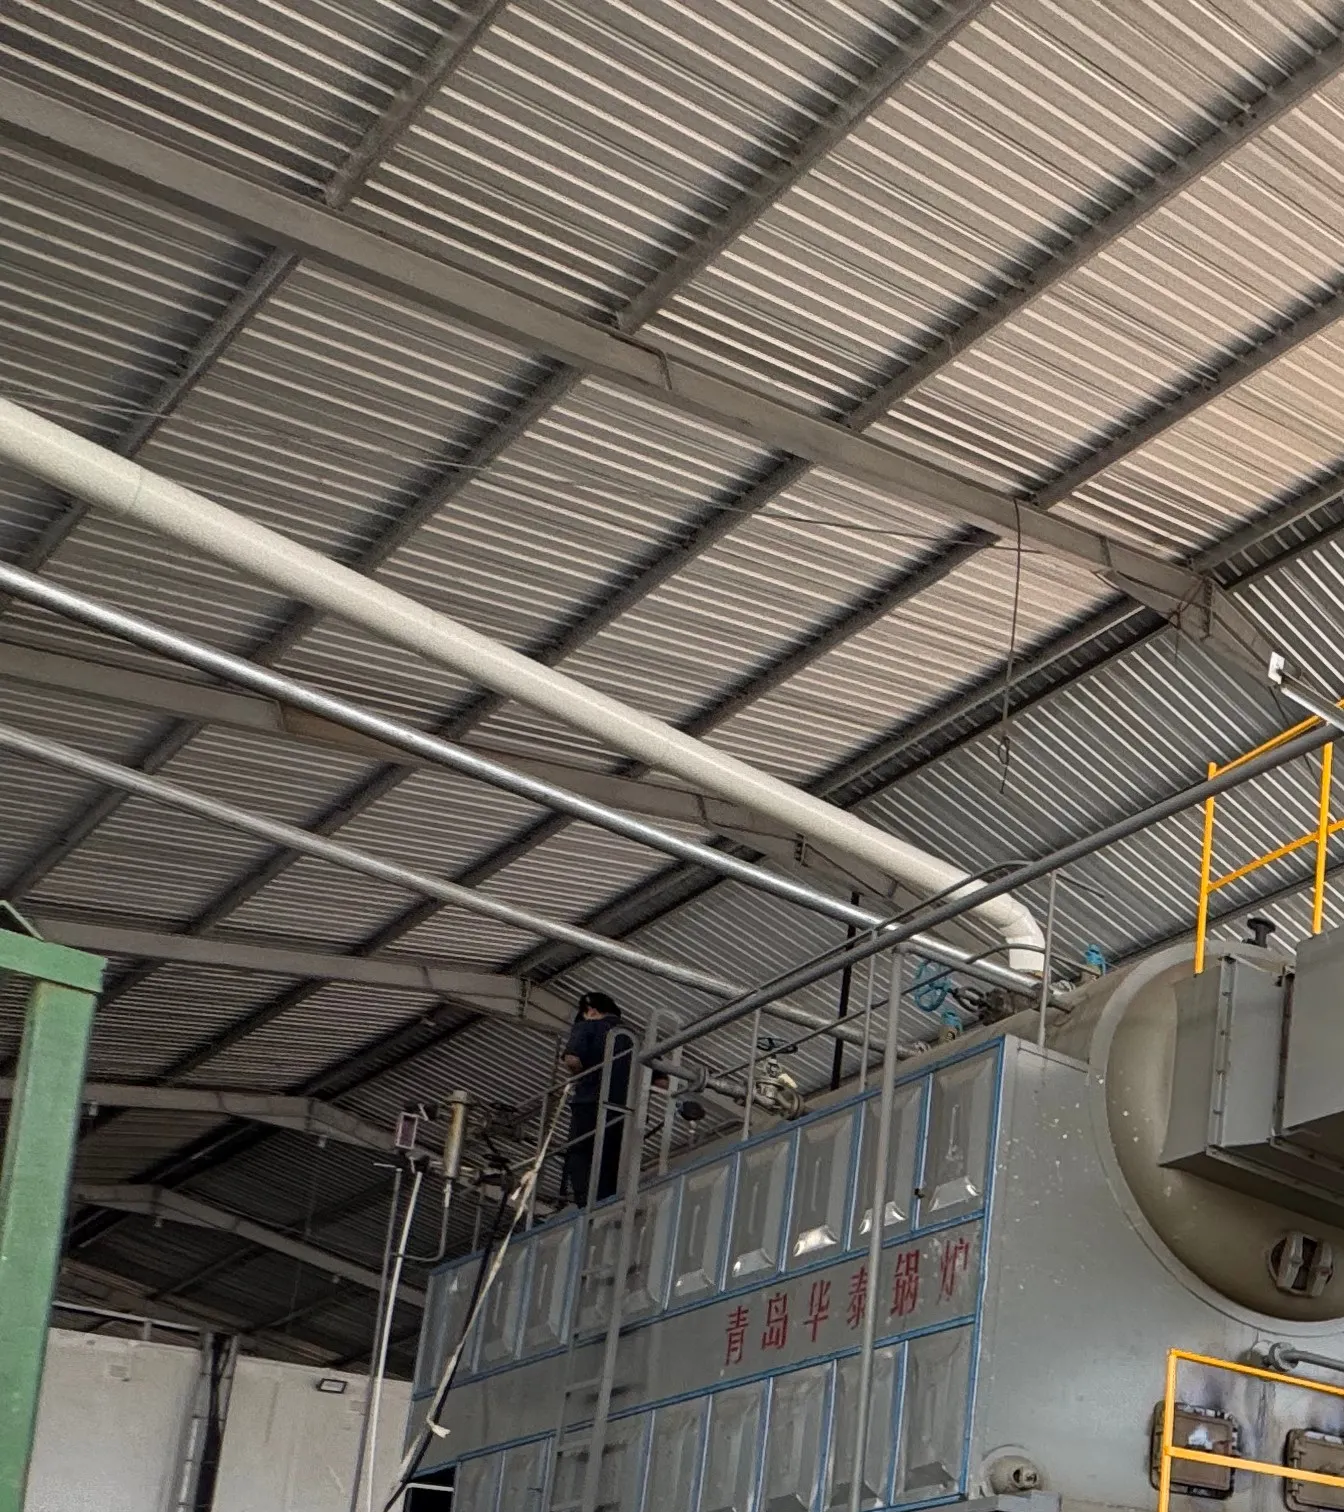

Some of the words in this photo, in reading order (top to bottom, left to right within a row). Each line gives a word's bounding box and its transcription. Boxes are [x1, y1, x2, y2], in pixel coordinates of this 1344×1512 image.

[724, 1237, 970, 1366] 青岛华泰锅炉
